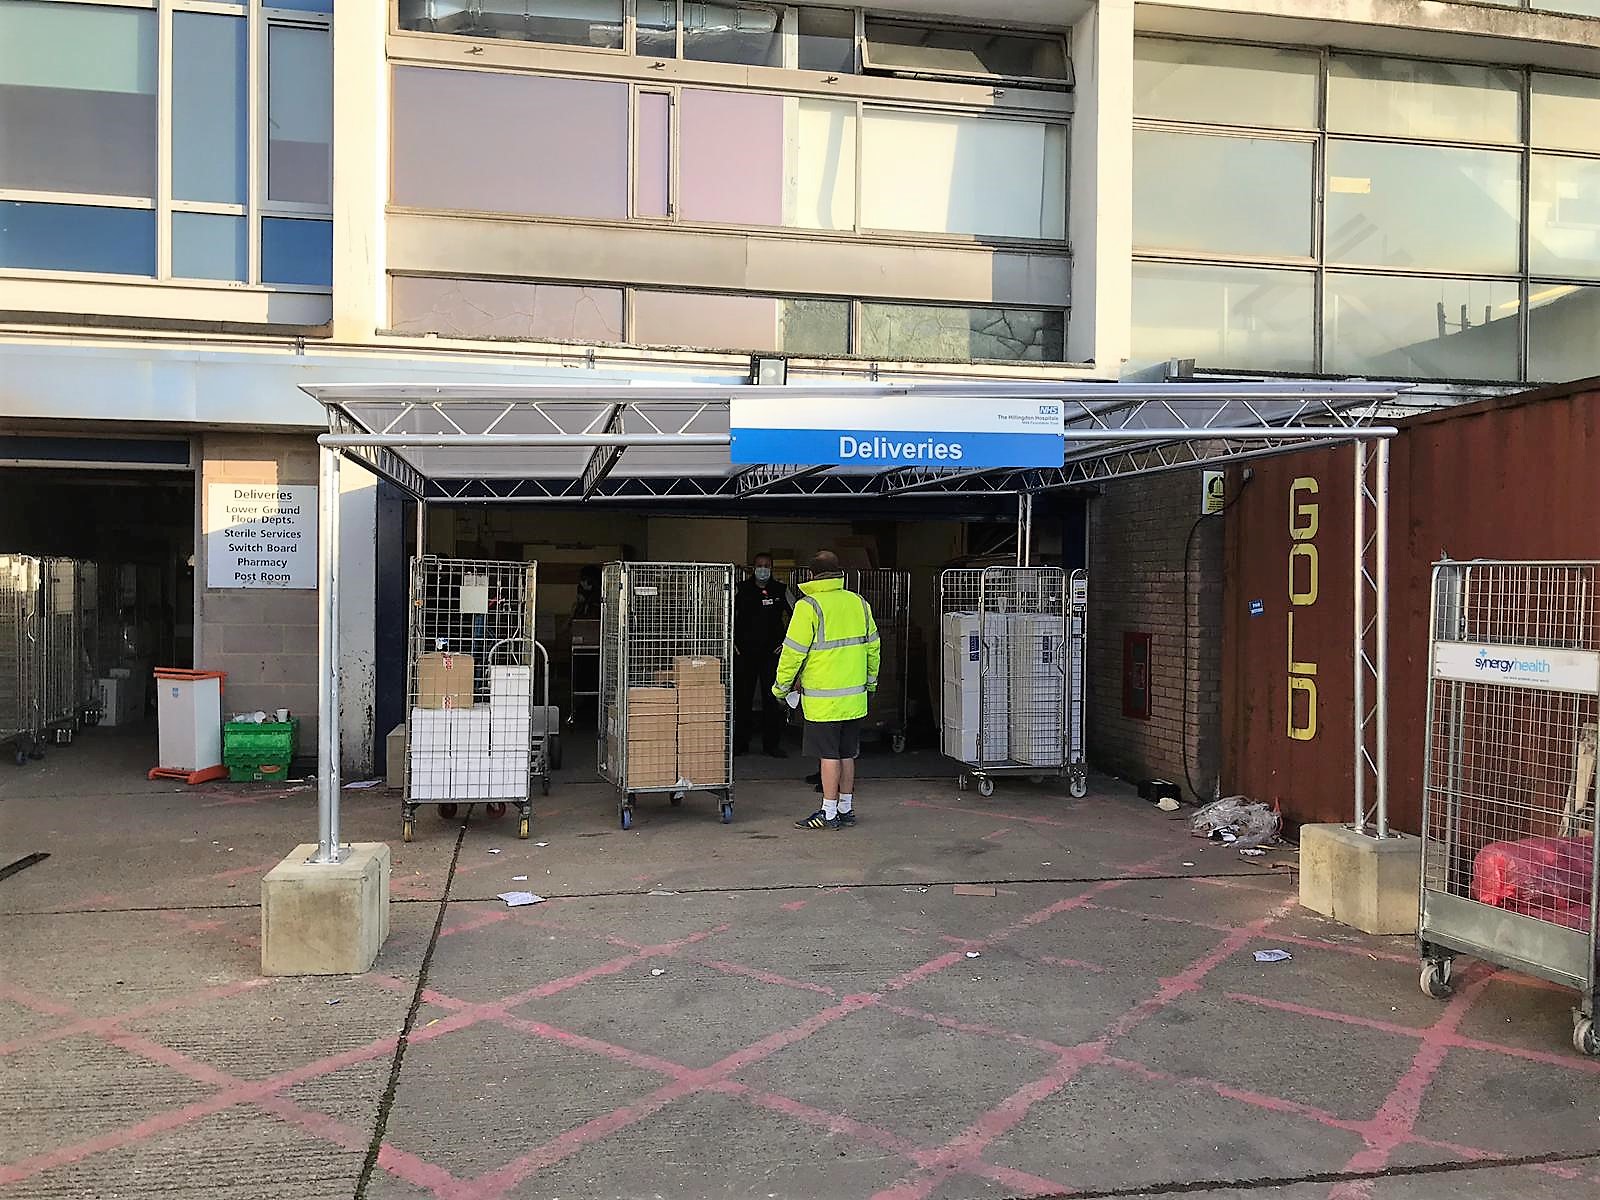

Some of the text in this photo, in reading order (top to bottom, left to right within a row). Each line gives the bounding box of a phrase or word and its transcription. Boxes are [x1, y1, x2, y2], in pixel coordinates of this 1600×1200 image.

[1040, 406, 1058, 414] NHS
[839, 435, 963, 460] Deliveries
[234, 489, 293, 500] Deliveries
[226, 505, 301, 515] Lower Ground
[231, 515, 295, 526] Floor Depts.
[224, 529, 302, 539] Sterile Services
[228, 543, 297, 553] Switch Board
[237, 557, 288, 569] Pharmacy
[234, 571, 291, 581] Post Room
[1287, 477, 1319, 741] GOLD
